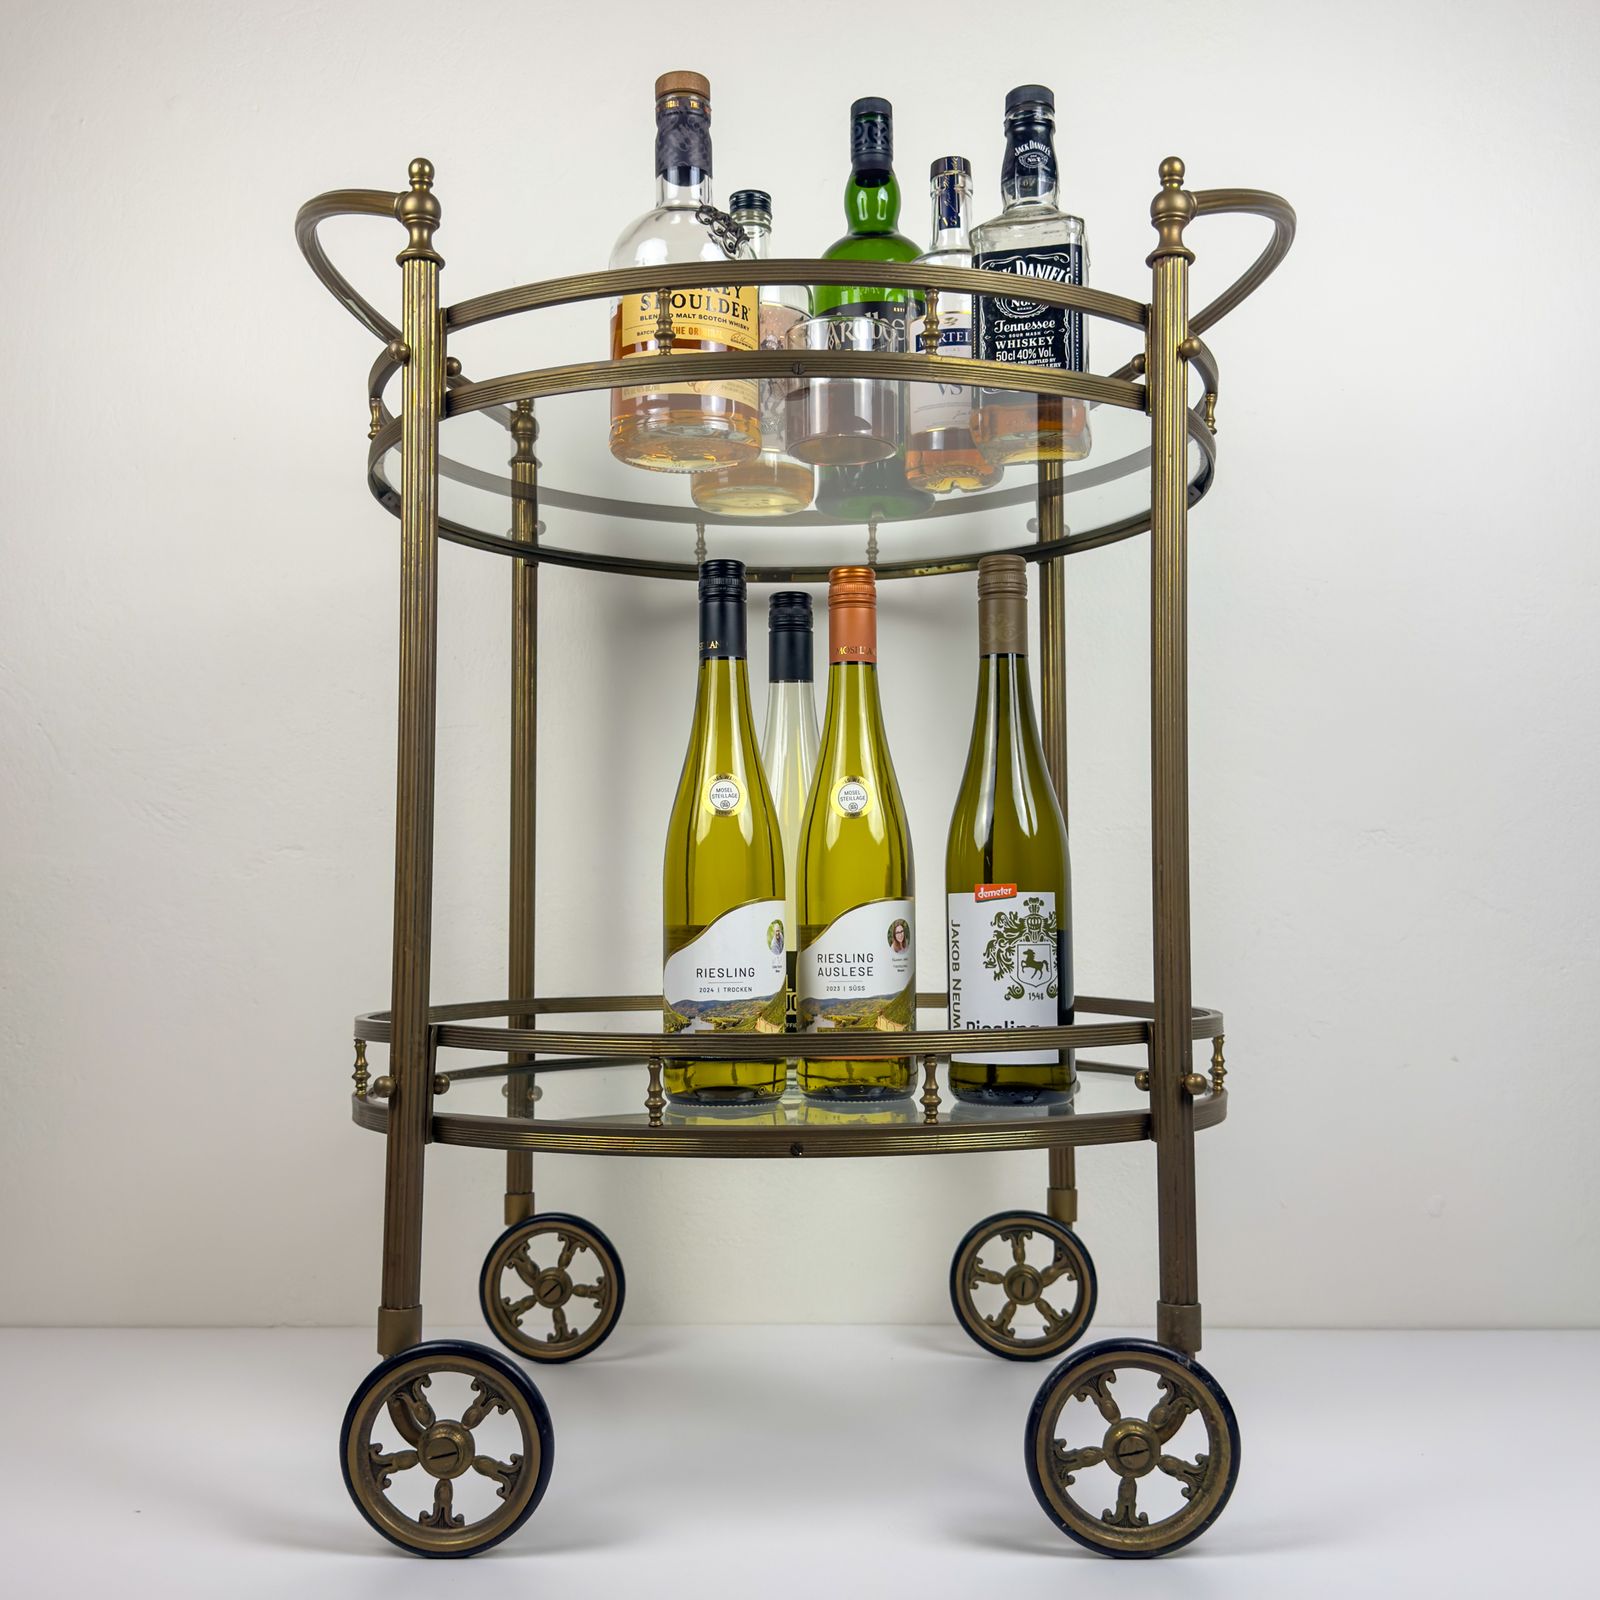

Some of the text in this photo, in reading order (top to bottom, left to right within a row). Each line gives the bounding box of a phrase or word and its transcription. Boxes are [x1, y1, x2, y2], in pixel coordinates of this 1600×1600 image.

[641, 293, 749, 322] SOULDER
[698, 314, 727, 324] SCOTCH
[994, 319, 1056, 334] Tennessee
[995, 335, 1055, 350] WHISKEY
[996, 346, 1054, 362] 50cl 40% Vol.
[977, 887, 1013, 899] demeter
[951, 919, 960, 973] JAKOB
[816, 952, 874, 964] RIESLING
[695, 967, 756, 979] RIESLING
[816, 966, 874, 977] AUSLESE
[848, 984, 866, 992] SÜSS
